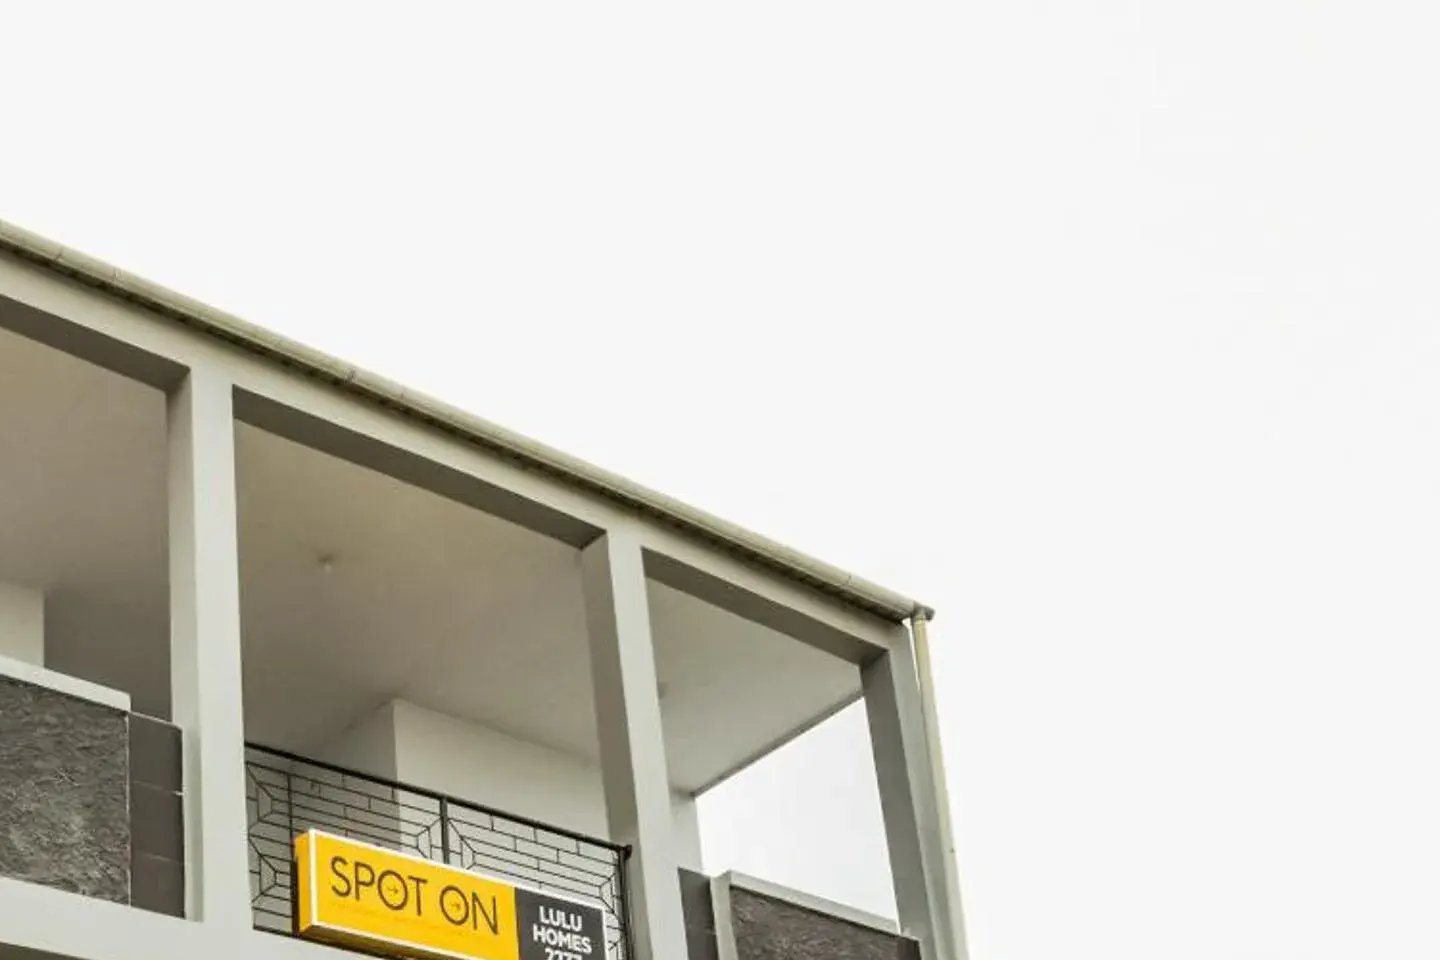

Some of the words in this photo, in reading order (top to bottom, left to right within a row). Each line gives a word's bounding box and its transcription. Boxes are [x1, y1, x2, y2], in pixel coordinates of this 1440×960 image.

[331, 856, 427, 917] SPOT
[439, 885, 499, 935] ON
[538, 905, 582, 932] LULU
[533, 925, 592, 954] HOMES
